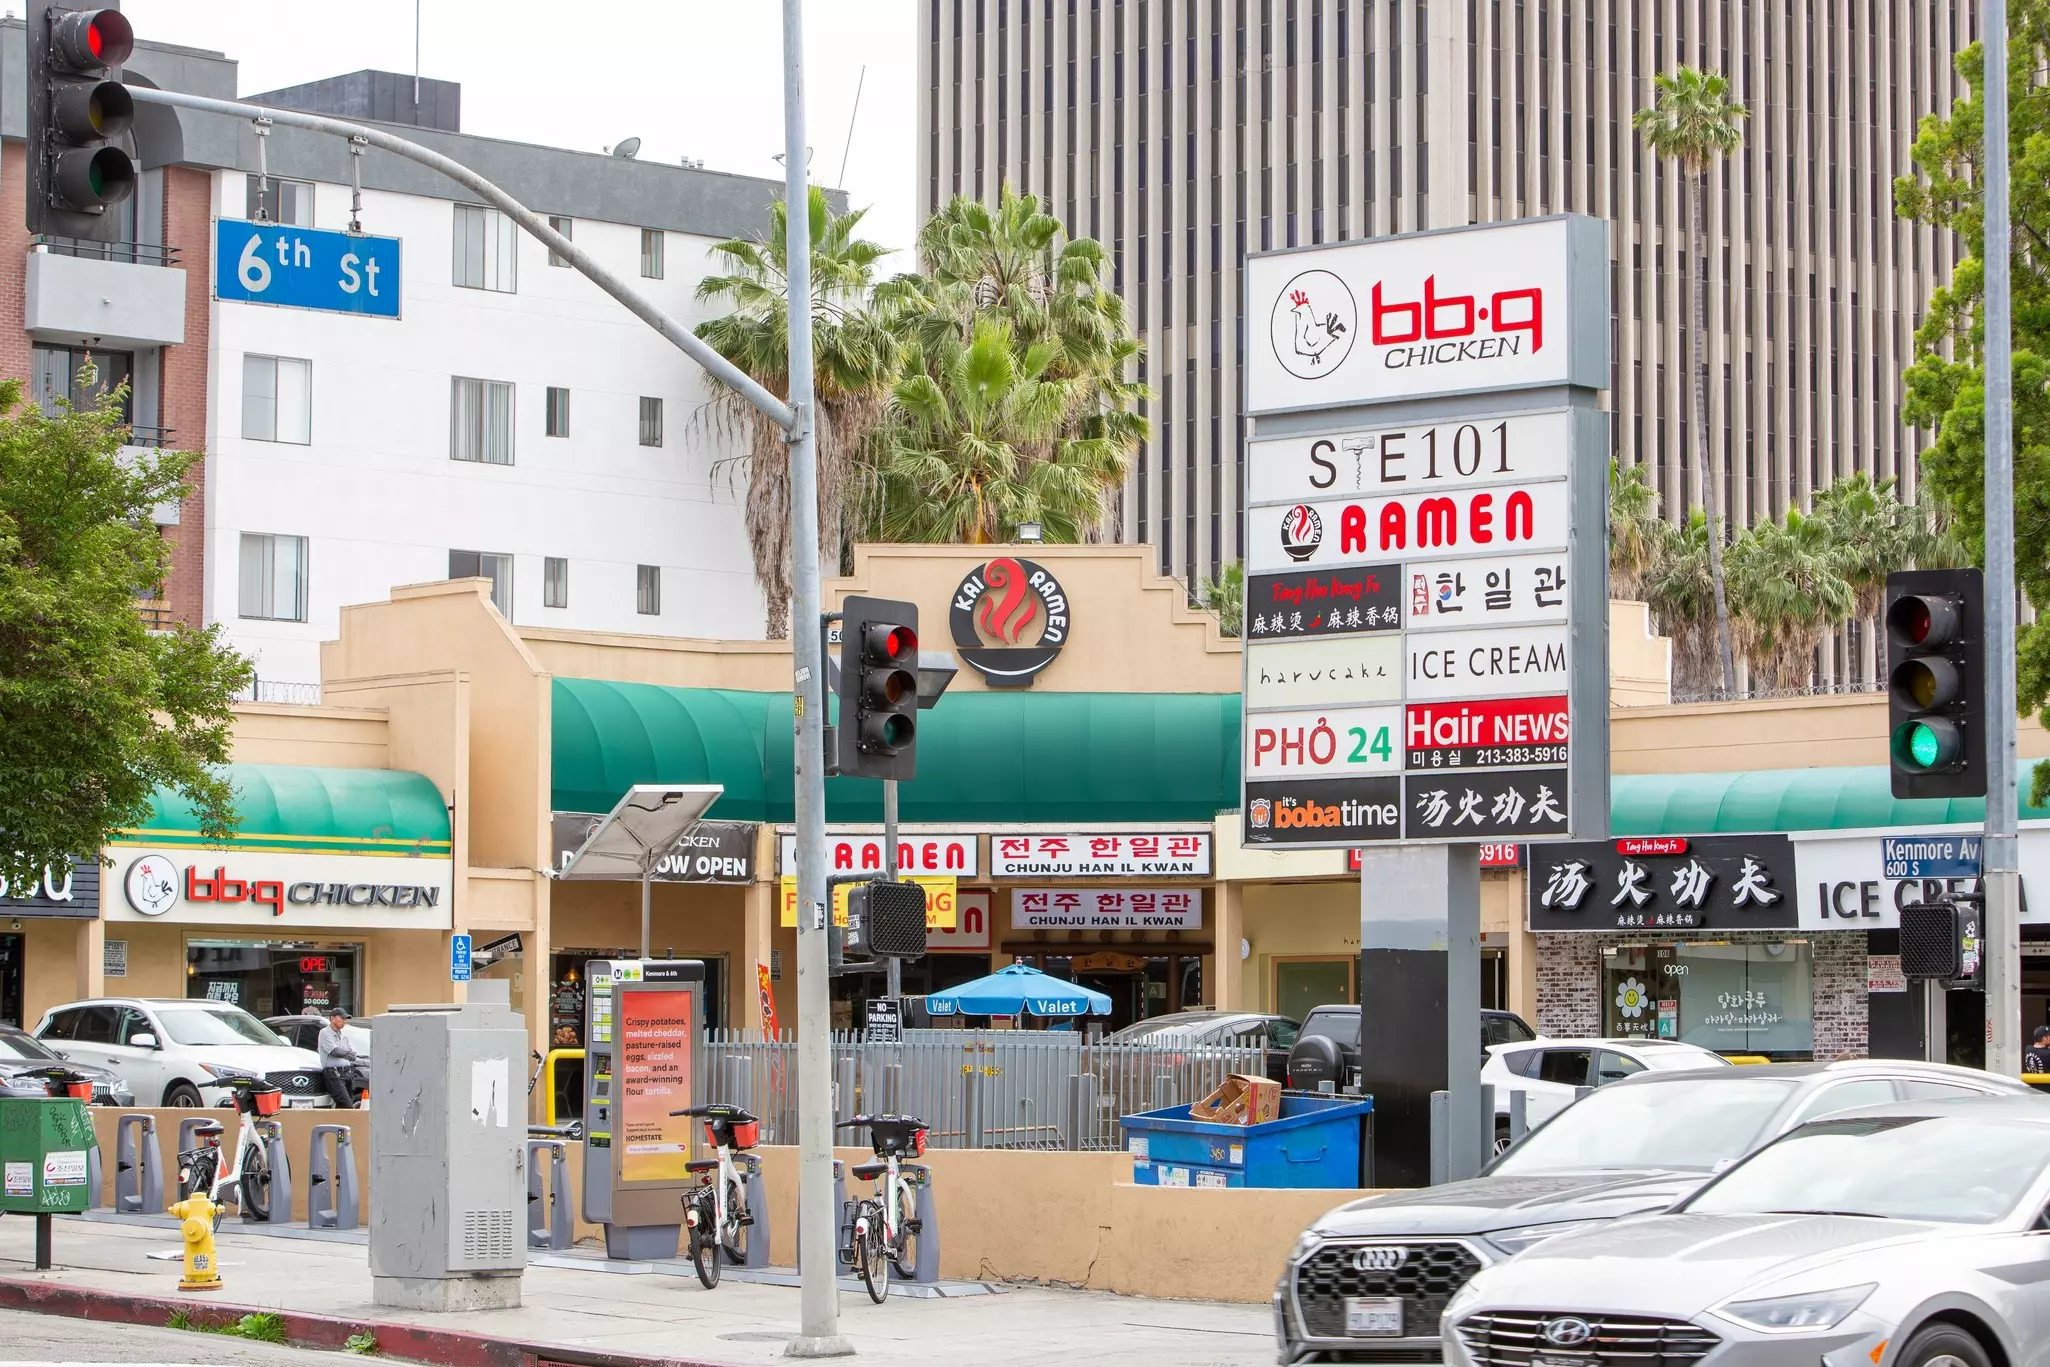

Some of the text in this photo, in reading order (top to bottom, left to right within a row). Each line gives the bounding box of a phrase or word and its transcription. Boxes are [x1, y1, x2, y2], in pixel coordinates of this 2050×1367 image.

[237, 233, 380, 297] 6th St
[1384, 335, 1521, 369] CHICKEN
[1340, 490, 1534, 554] RAMEN
[955, 570, 1067, 643] KAI RAMEN
[1251, 605, 1399, 634] 麻辣烫 麻辣香锅
[1413, 642, 1566, 680] ICE CREAM
[1407, 708, 1569, 747] Hair NEWS
[1347, 726, 1393, 763] 24
[1476, 746, 1568, 764] 213-383-5916
[1282, 796, 1298, 807] it's
[1000, 836, 1203, 860] 전주 한일관
[1885, 838, 1979, 861] Kenmore Av
[652, 855, 747, 877] OW OPEN
[1004, 862, 1194, 873] CHUNJU HAN IL KWAN
[1886, 861, 1920, 877] 600 S
[287, 880, 441, 908] CHICKEN
[1818, 880, 1880, 920] ICE
[1021, 893, 1192, 913] 전주 한일관
[1029, 916, 1184, 926] CHUNJU HAN IL KWAN
[301, 957, 336, 972] OPEN
[1664, 964, 1689, 977] open
[876, 1002, 887, 1012] NO
[932, 999, 1077, 1013] Valet Valet
[625, 1017, 686, 1028] Crispy potatoes,
[868, 1013, 897, 1024] PARKING
[626, 1029, 687, 1038] melted cheddar,
[625, 1040, 681, 1051] pasture-raised
[625, 1052, 674, 1062] eggs, sizzled
[625, 1064, 651, 1073] bacon,
[652, 1064, 668, 1072] and
[625, 1075, 683, 1085] award-winning
[625, 1087, 644, 1096] flour
[625, 1134, 663, 1142] HOMESTATE
